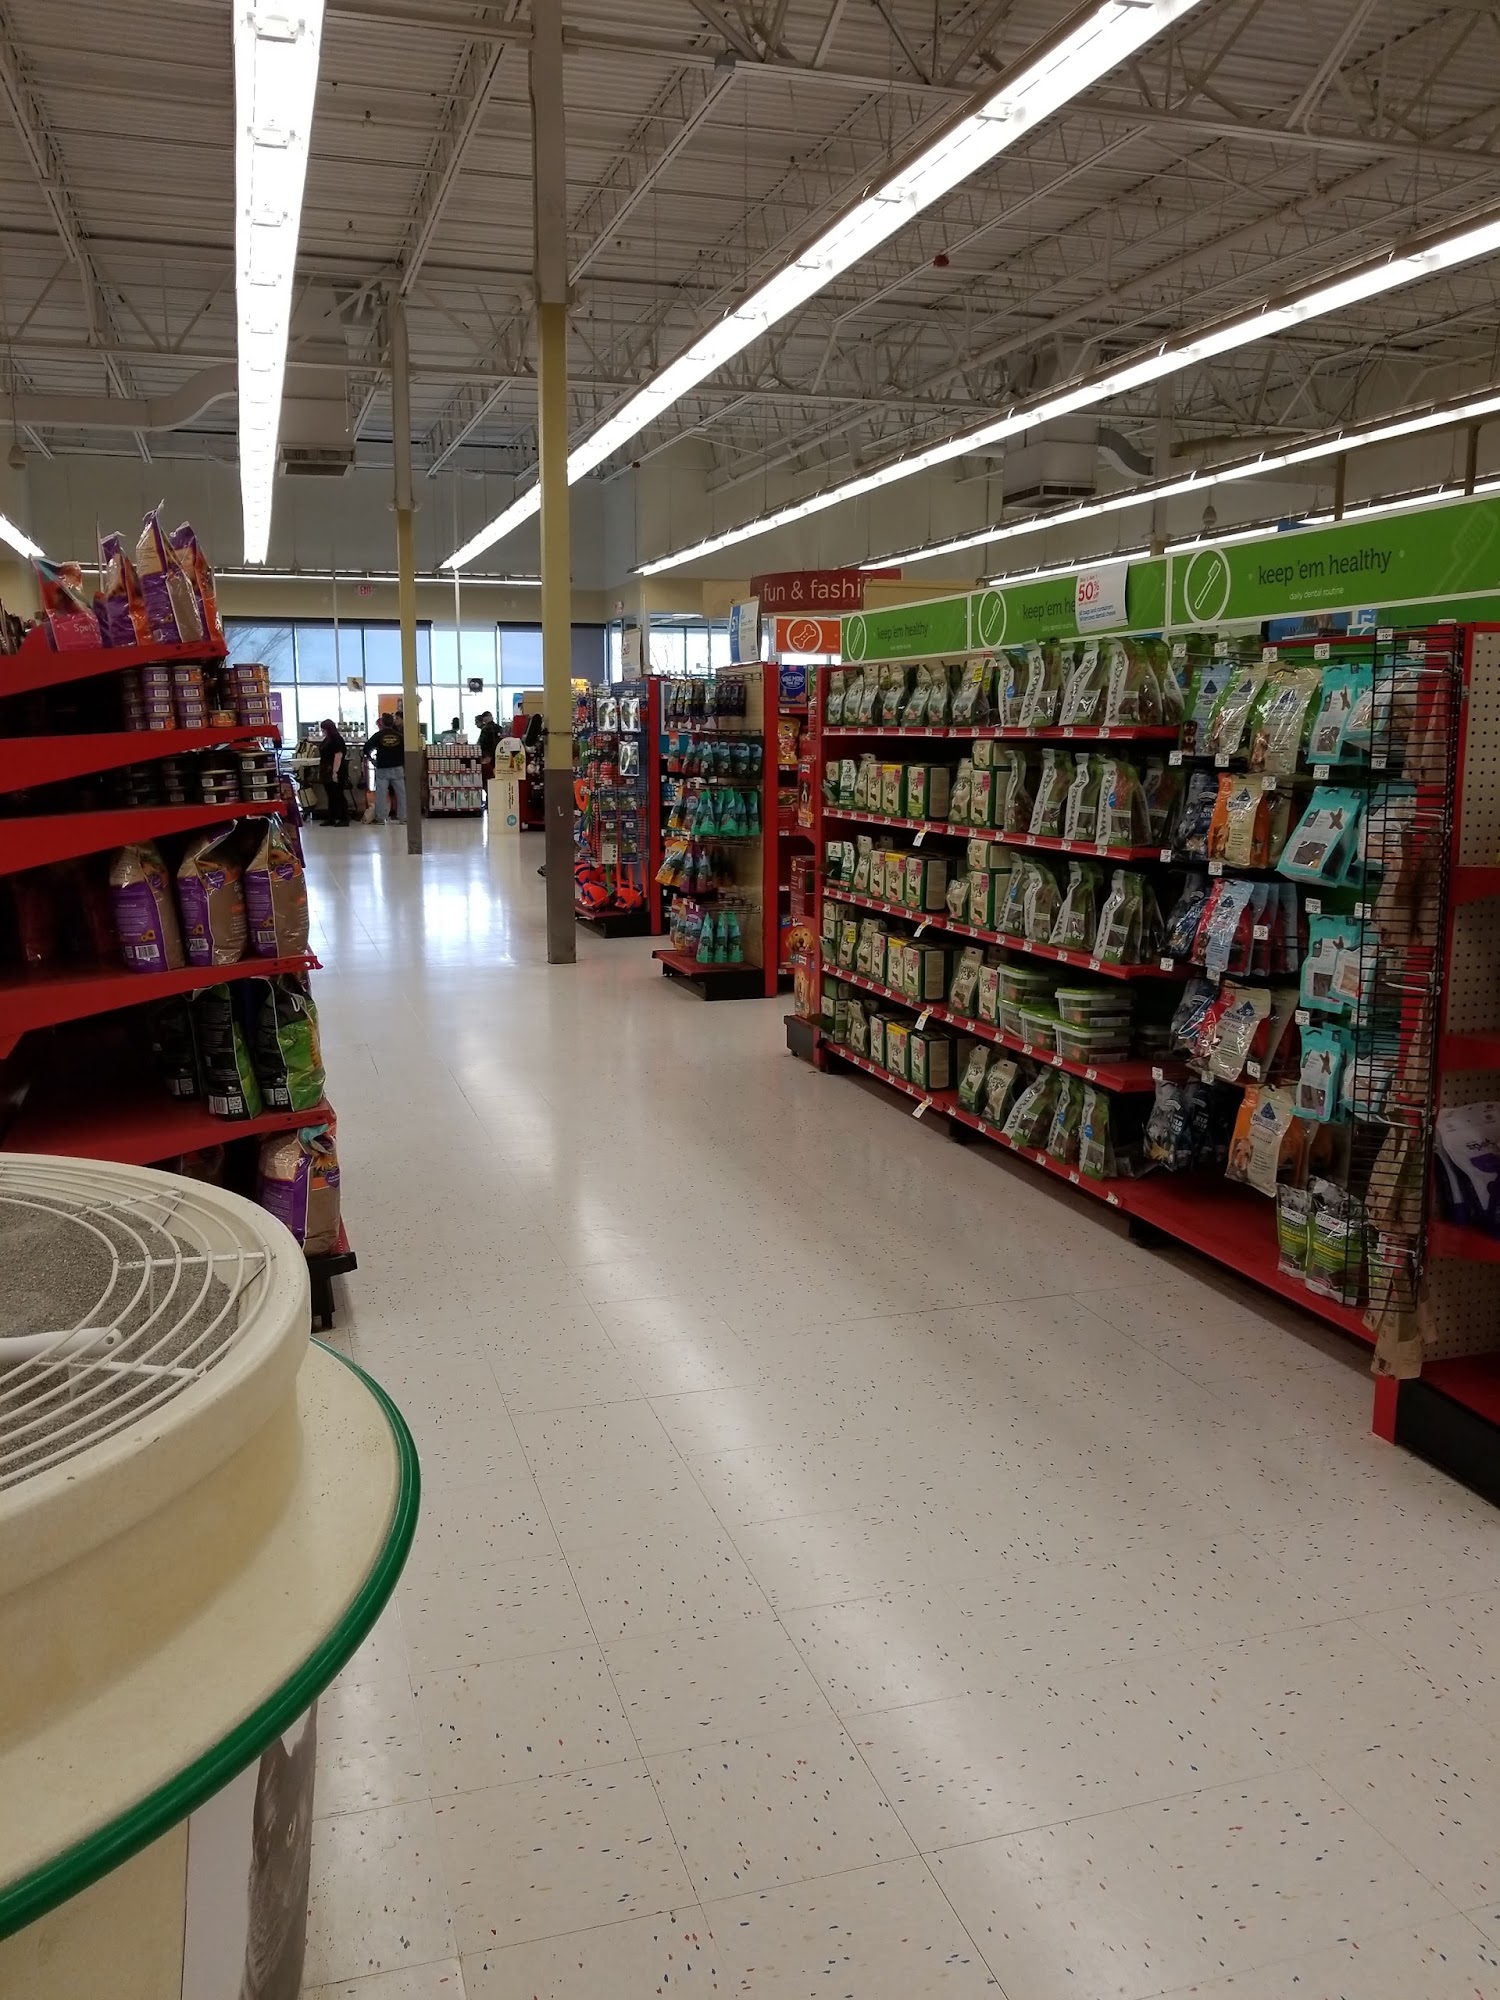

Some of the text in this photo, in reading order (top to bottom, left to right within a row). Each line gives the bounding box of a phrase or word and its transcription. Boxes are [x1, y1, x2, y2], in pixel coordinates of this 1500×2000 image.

[1258, 565, 1294, 587] keep
[1328, 547, 1393, 575] healthy
[763, 583, 786, 602] fun
[790, 580, 804, 600] &
[1289, 586, 1344, 601] daily dental routine
[1022, 603, 1045, 621] keep
[877, 627, 893, 642] keep
[904, 622, 929, 638] healthy
